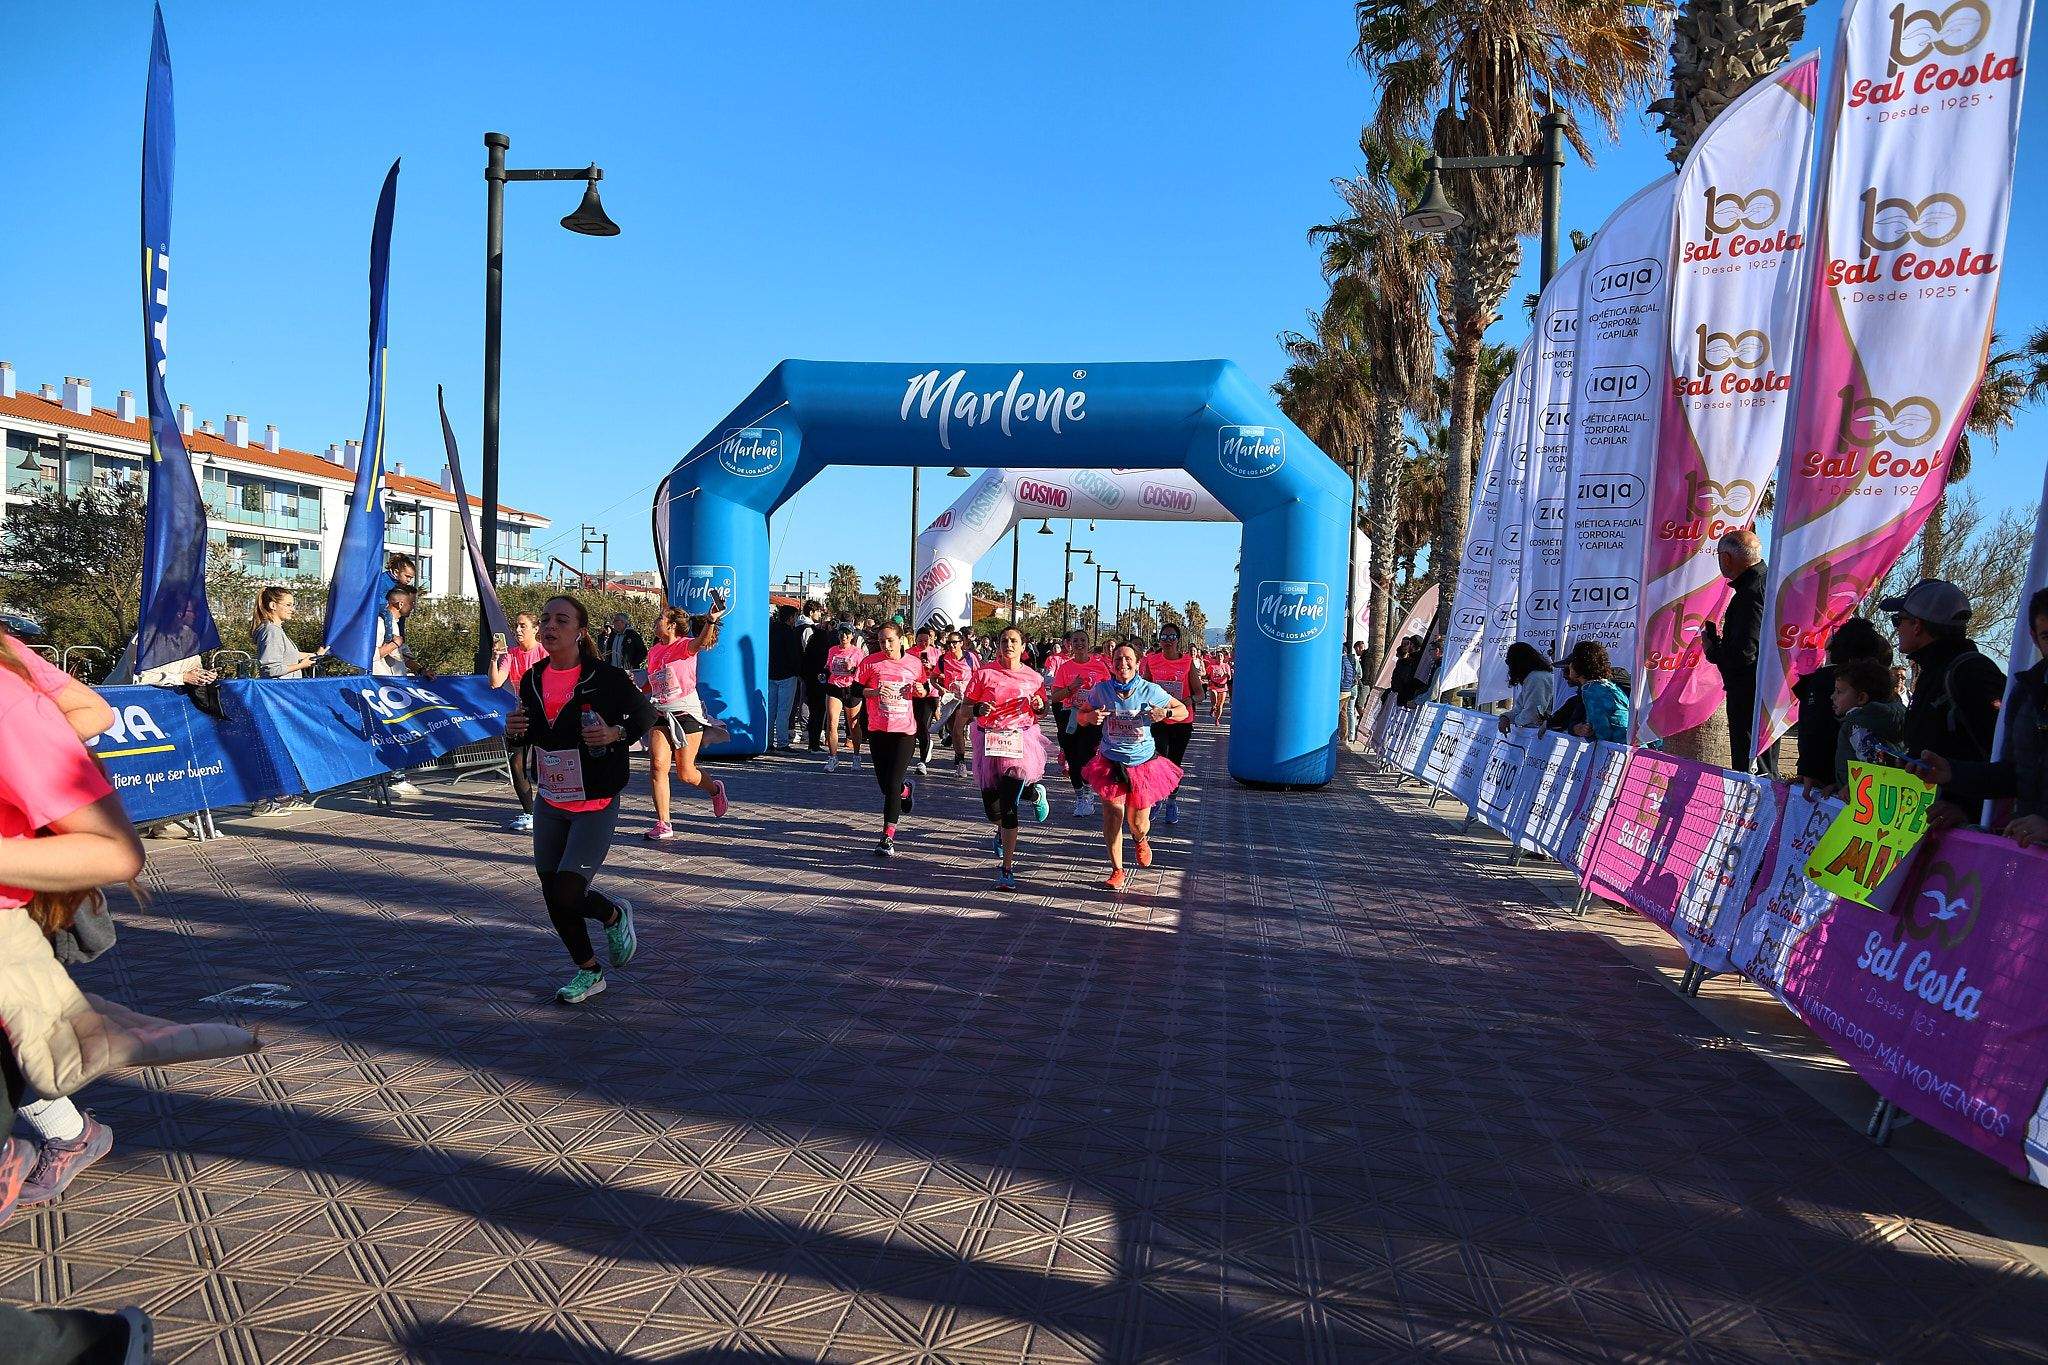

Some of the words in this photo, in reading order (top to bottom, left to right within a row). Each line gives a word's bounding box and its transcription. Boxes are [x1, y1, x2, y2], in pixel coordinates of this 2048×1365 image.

[1848, 72, 1905, 108] Sal
[1914, 52, 2023, 95] Costa
[1878, 104, 1929, 123] Desde
[1941, 94, 1980, 110] 1925
[1683, 238, 1721, 263] Sal
[1728, 229, 1805, 257] Costa
[1702, 264, 1741, 275] Desde
[1749, 259, 1776, 270] 1925
[1825, 256, 1881, 287] Sal
[1892, 247, 1998, 282] Costa
[1853, 291, 1908, 303] Desde
[1919, 286, 1956, 299] 1925
[1602, 329, 1639, 340] CAPILAR
[1593, 374, 1637, 397] iaja
[1672, 374, 1713, 397] Sal
[1720, 370, 1792, 395] Costa
[900, 369, 1087, 450] Marlene
[1694, 401, 1732, 410] Desde
[1740, 398, 1766, 408] 1925
[724, 438, 778, 463] Marlene
[1223, 437, 1280, 464] Marlene
[1590, 436, 1628, 445] CAPILAR
[1801, 451, 1860, 479] Sal
[1019, 481, 1068, 508] COSMO
[1142, 484, 1193, 511] COSMO
[1830, 485, 1883, 496] Desde
[1578, 530, 1625, 539] CORPORAL
[1658, 520, 1702, 541] Sal
[1579, 542, 1584, 550] Y
[1585, 541, 1624, 550] CAPILAR
[1261, 594, 1324, 626] Marlene
[1299, 626, 1318, 638] ALPES
[361, 685, 450, 718] GOYA
[145, 772, 164, 793] que
[168, 768, 185, 780] ser
[187, 760, 223, 777] bueno!
[1857, 931, 1907, 982] Sal
[1903, 950, 1983, 1021] Costa
[1866, 987, 1904, 1018] Desde
[1846, 1023, 1874, 1055] POR
[1902, 1059, 2010, 1137] MOMENTOS
